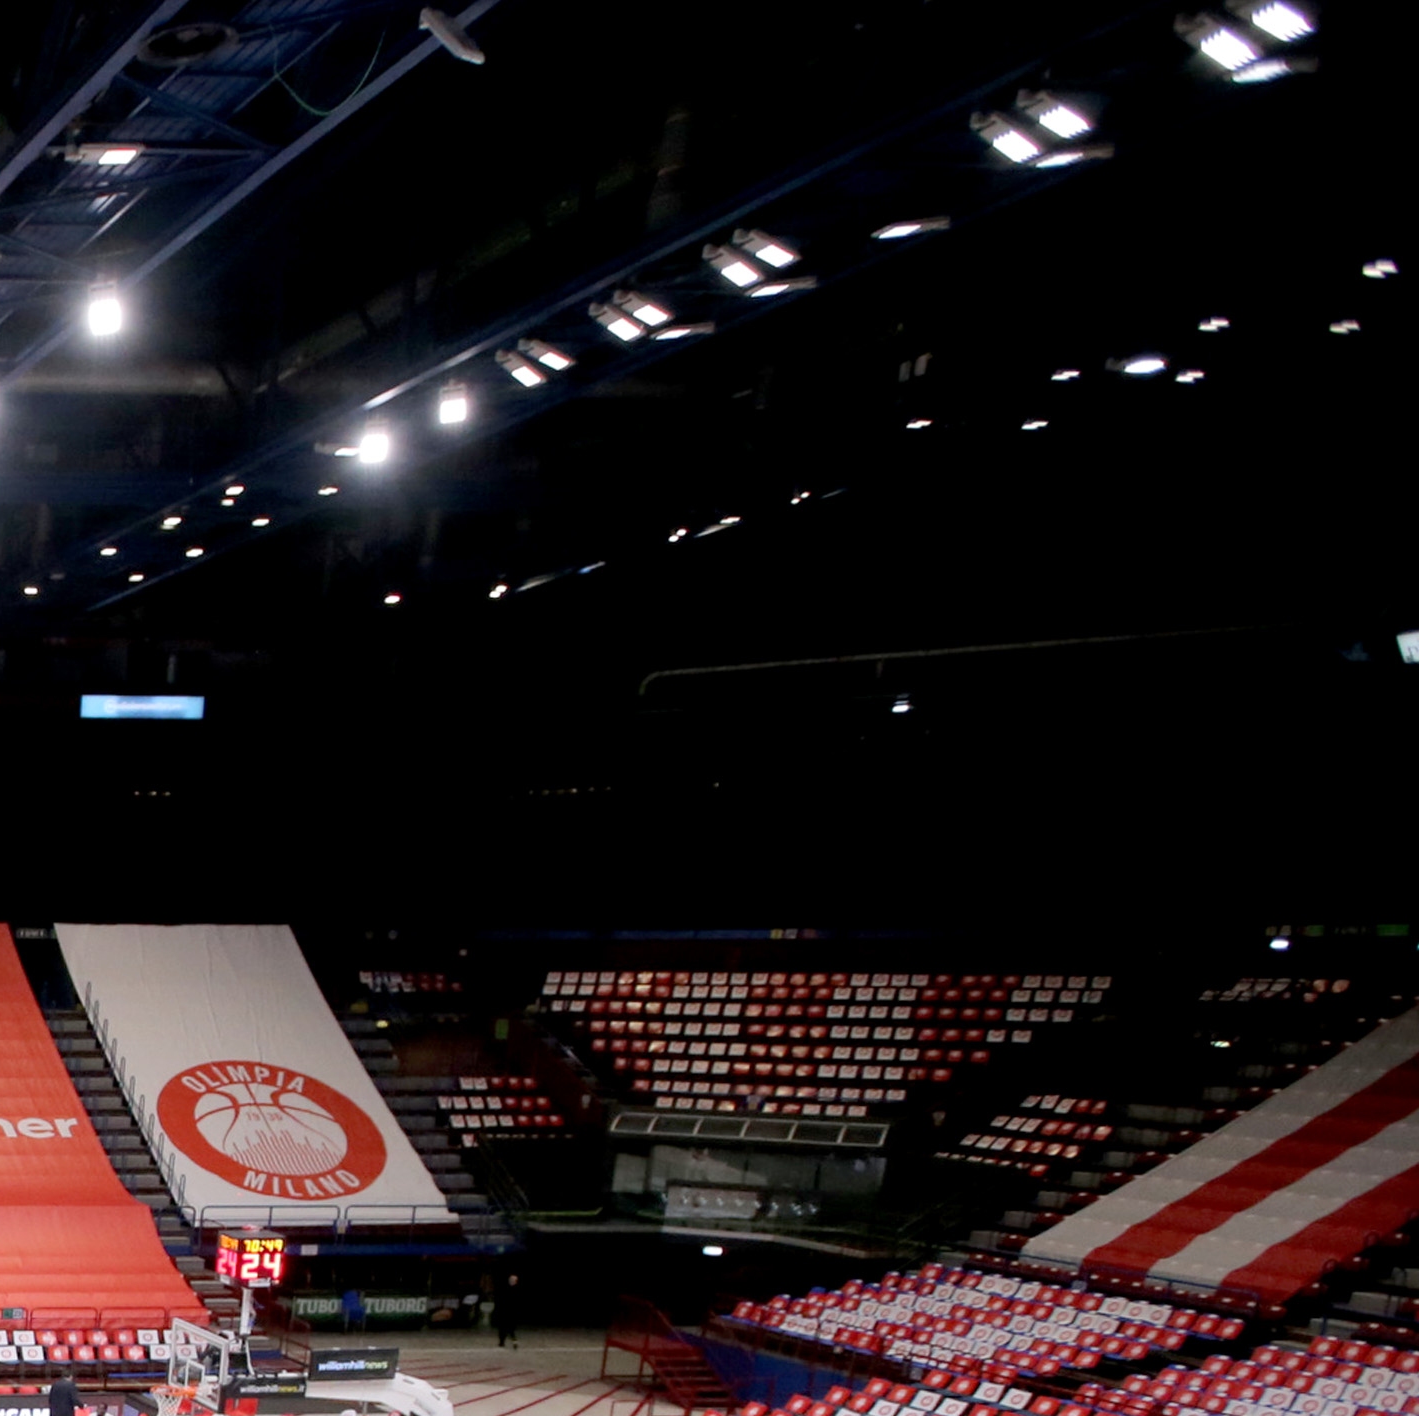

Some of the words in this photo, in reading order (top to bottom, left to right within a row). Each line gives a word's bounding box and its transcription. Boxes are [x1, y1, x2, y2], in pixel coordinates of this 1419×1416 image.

[181, 1062, 306, 1095] OLIMPIA
[244, 1167, 361, 1197] MILANO
[241, 1252, 282, 1279] 24
[296, 1298, 339, 1315] TUBO
[365, 1297, 428, 1314] TUBORG
